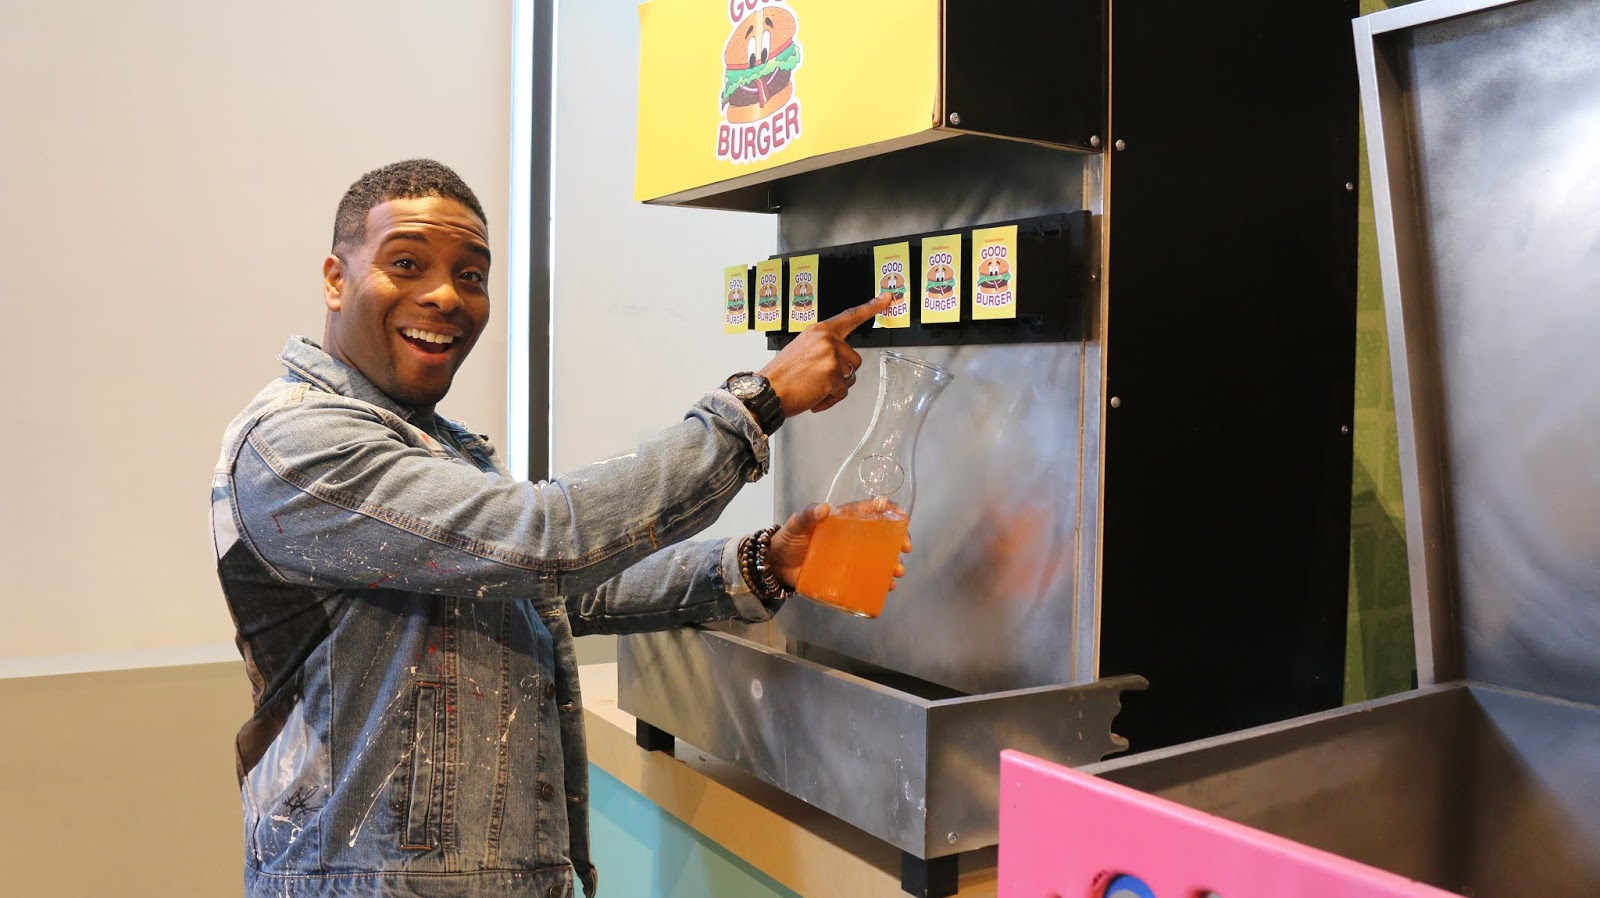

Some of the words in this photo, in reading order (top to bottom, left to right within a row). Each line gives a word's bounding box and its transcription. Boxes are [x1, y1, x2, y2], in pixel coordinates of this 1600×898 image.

[717, 102, 800, 160] BURGER
[981, 245, 1007, 259] GOOD
[929, 253, 953, 266] GOOD
[881, 262, 903, 275] GOOD
[761, 274, 777, 285] GOOD
[795, 272, 812, 283] GOOD
[729, 279, 744, 290] GOOD
[924, 296, 957, 311] BURGER
[976, 291, 1012, 307] BURGER
[726, 313, 746, 325] BURGER
[757, 309, 780, 322] BURGER
[791, 309, 816, 322] BURGER
